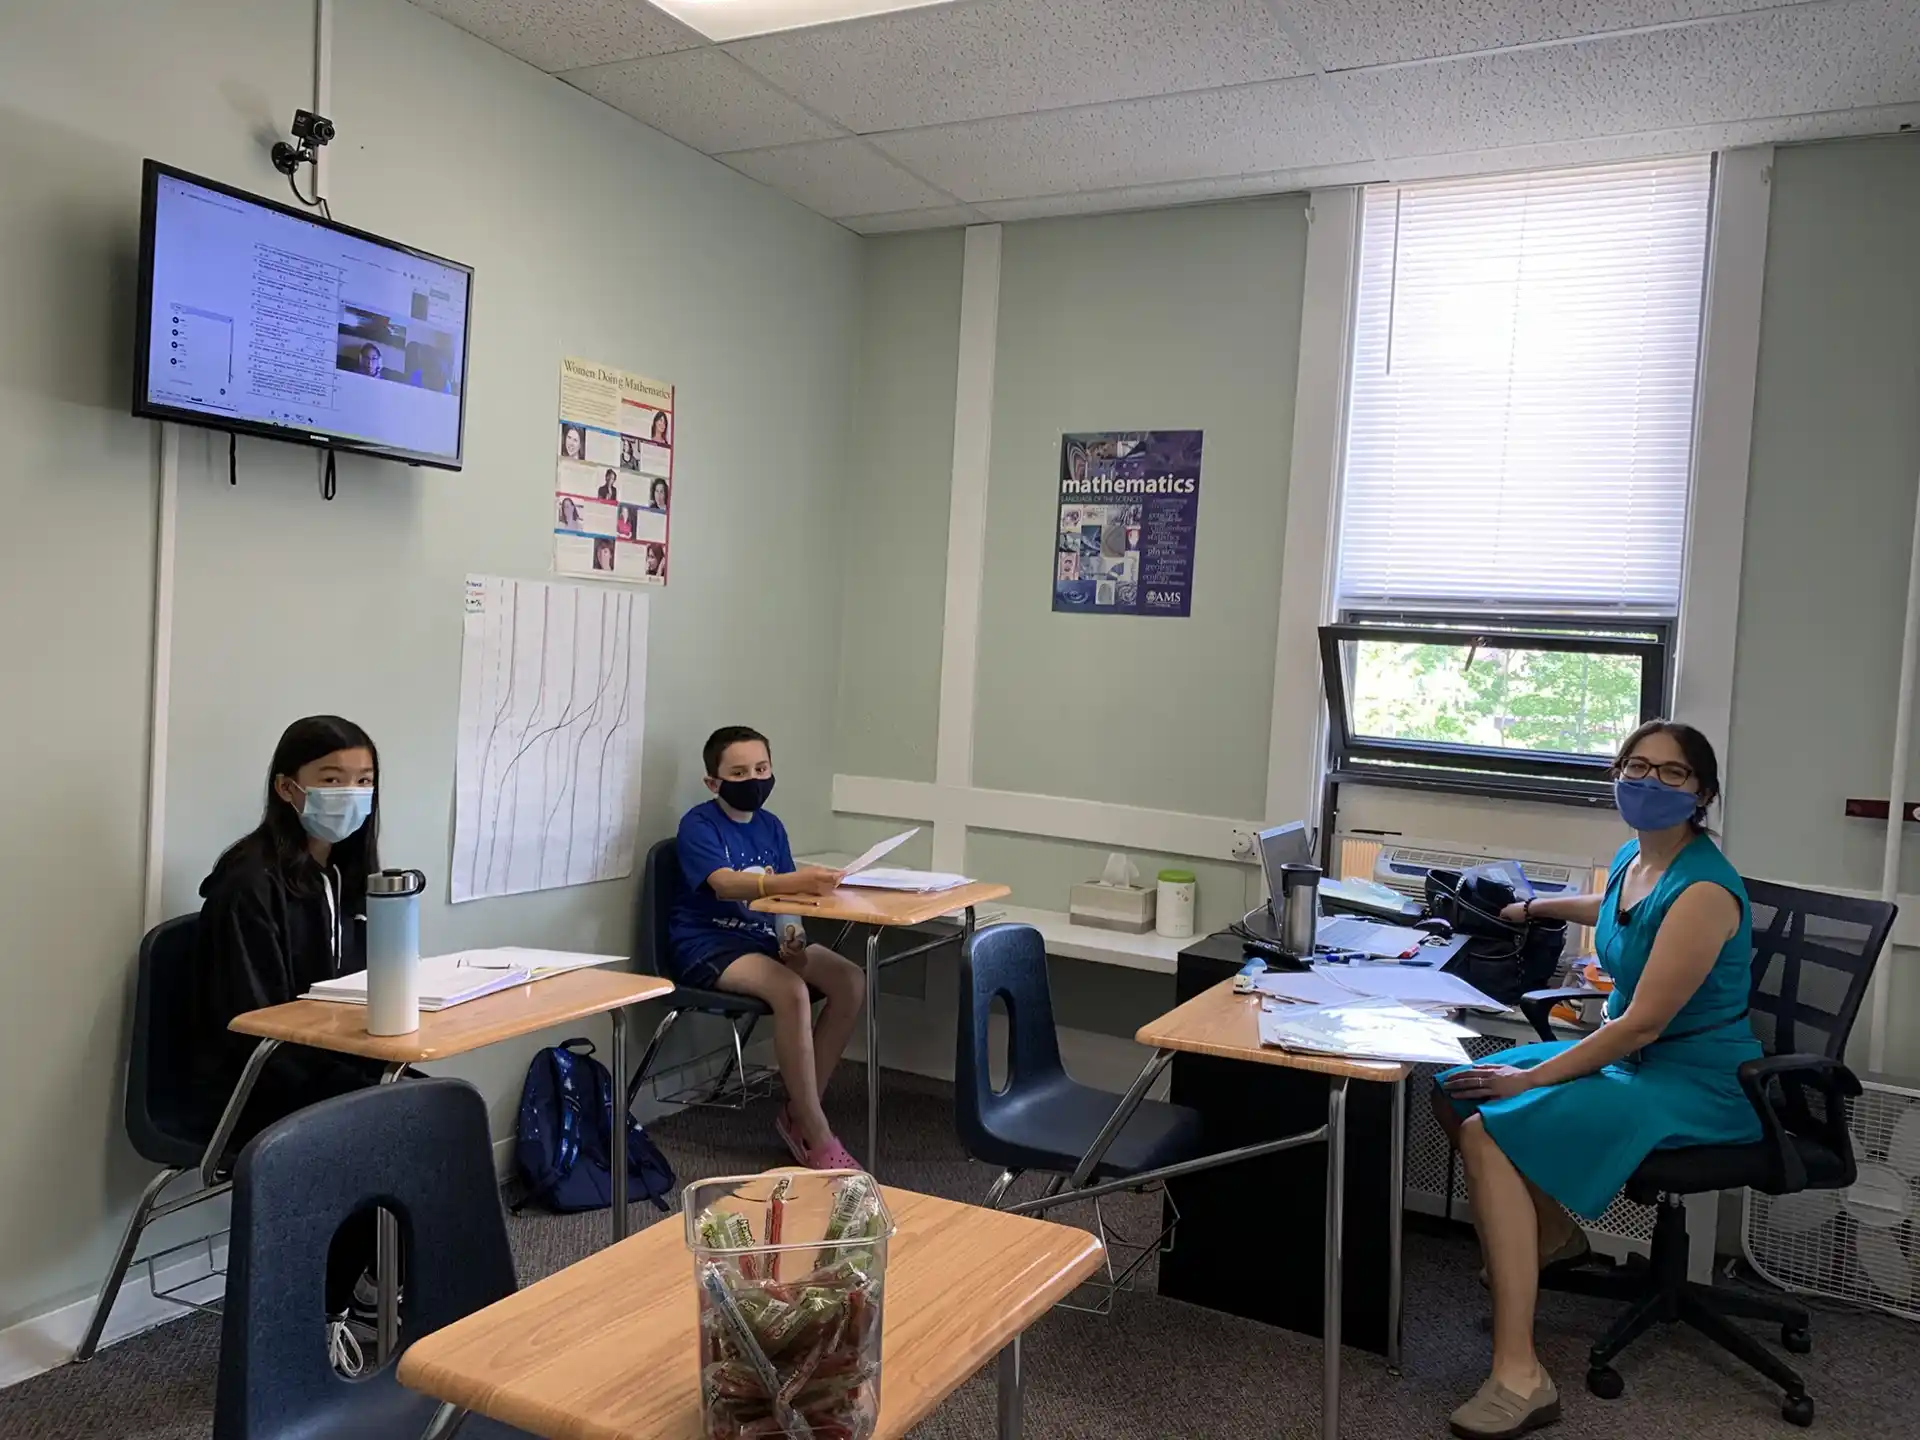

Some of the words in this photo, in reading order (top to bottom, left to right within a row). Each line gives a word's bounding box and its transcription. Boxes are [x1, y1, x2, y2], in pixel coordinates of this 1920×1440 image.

[564, 359, 596, 378] Women
[597, 368, 624, 390] Doing
[624, 377, 671, 399] Mathematics
[1062, 474, 1195, 493] mathematics
[1147, 546, 1176, 557] physics
[1155, 591, 1181, 603] AMS
